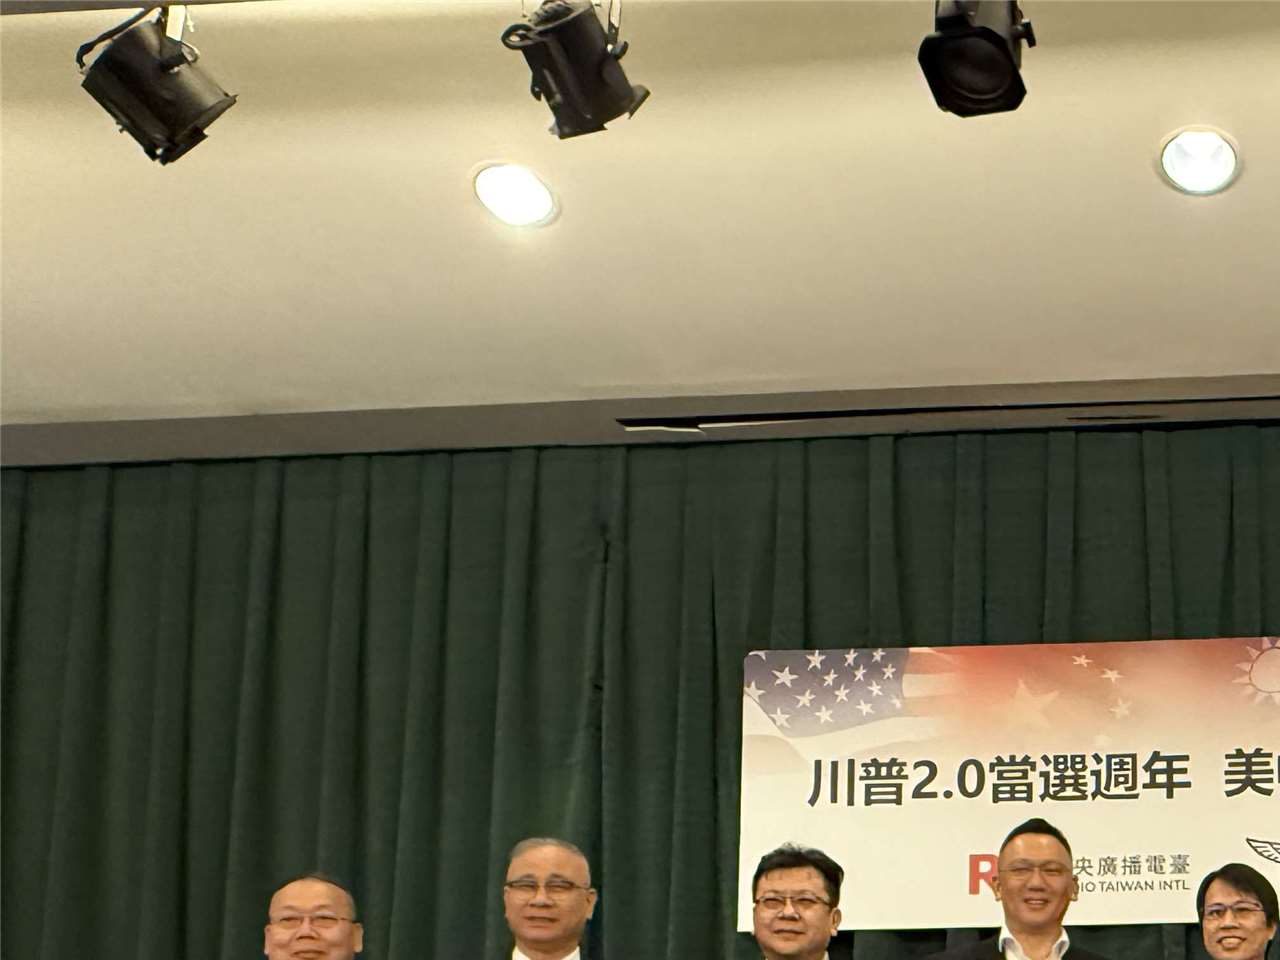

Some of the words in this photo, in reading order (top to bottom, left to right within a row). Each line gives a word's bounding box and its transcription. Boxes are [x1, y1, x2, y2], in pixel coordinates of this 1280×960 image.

[808, 750, 1192, 807] 川普2.0當選週年
[1073, 853, 1190, 876] 央廣播電臺
[1099, 880, 1154, 893] TAIWAN
[1159, 879, 1190, 891] INTL
